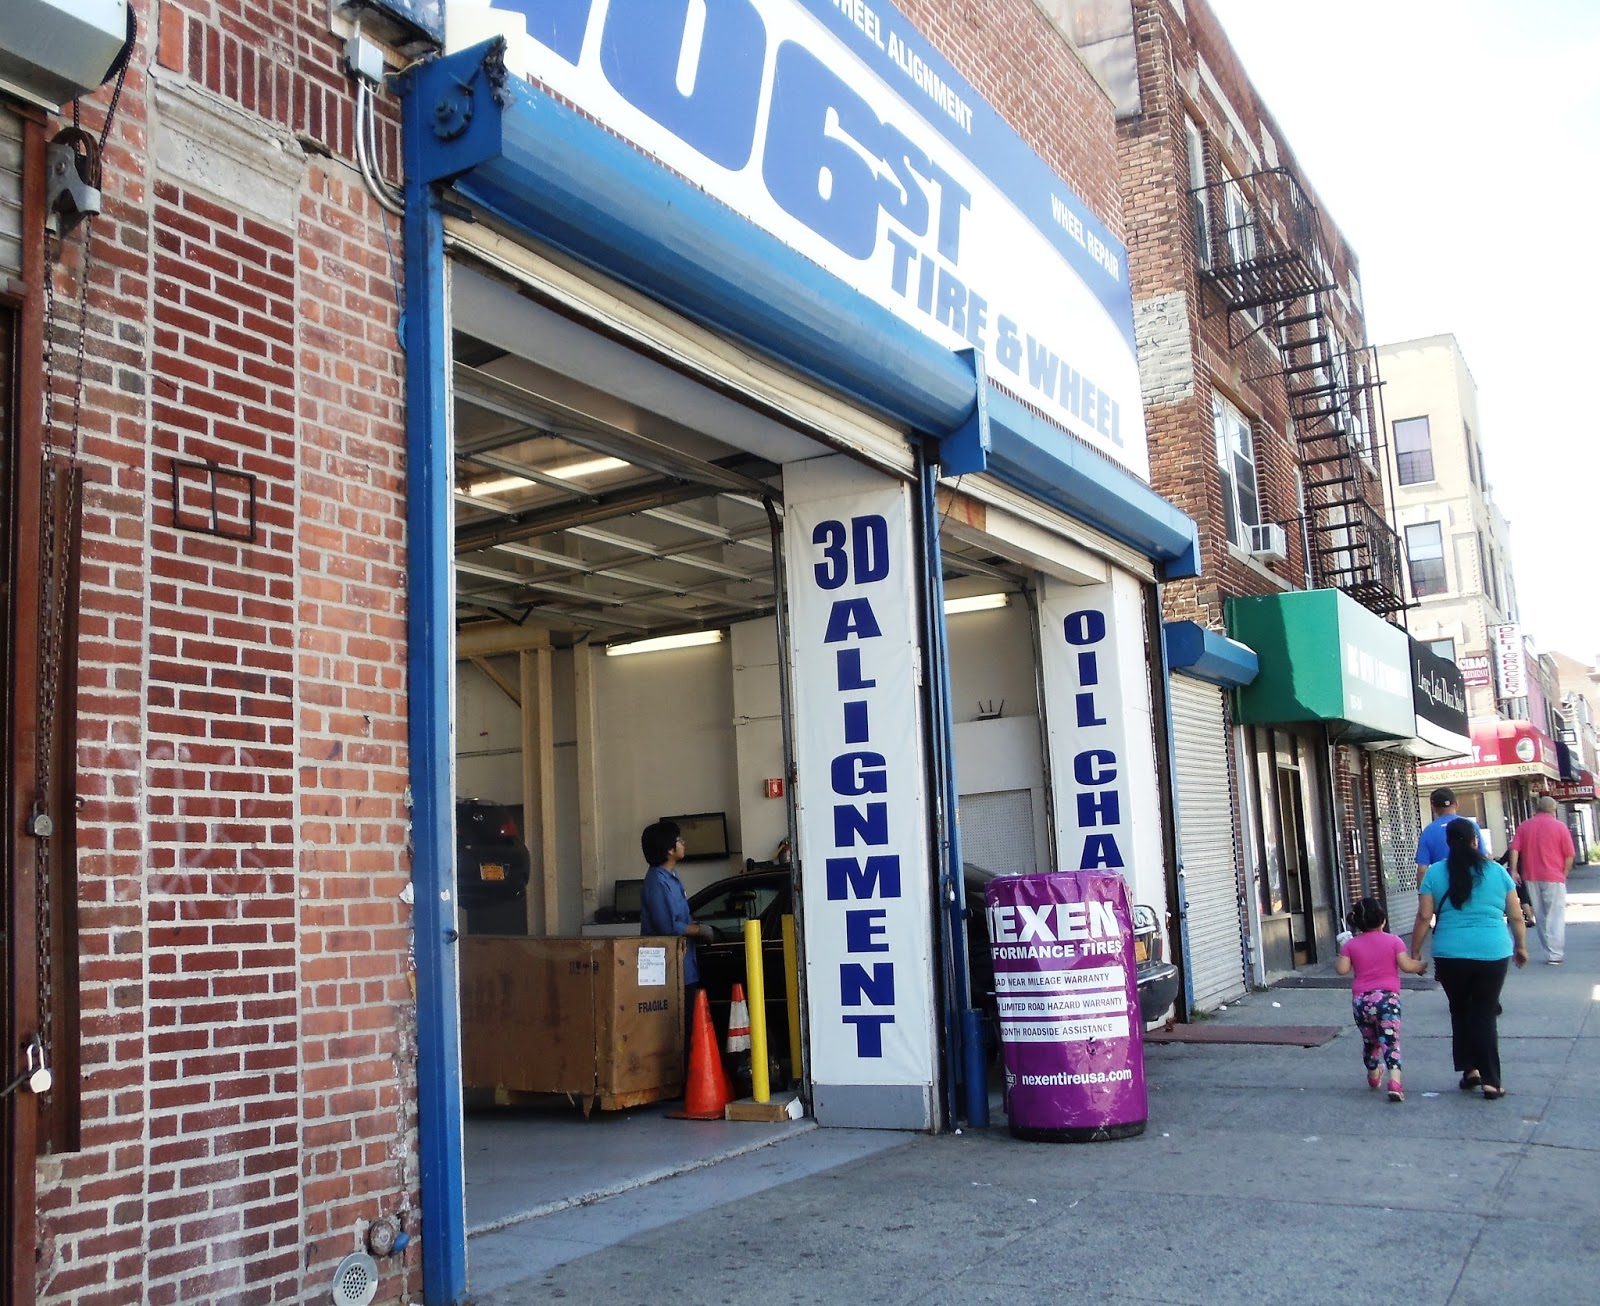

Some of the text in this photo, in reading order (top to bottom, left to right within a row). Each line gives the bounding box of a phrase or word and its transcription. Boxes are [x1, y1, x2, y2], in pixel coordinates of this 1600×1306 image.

[887, 30, 973, 135] ALIGNMENT
[1050, 192, 1120, 282] WHEEL REPAIR
[887, 227, 1124, 448] TIRE & WHEEL
[812, 514, 890, 591] 3D
[1063, 608, 1106, 728] OIL
[824, 596, 901, 1059] ALIGNMENT
[990, 940, 1122, 960] FORMANCE TIRES
[1008, 976, 1026, 987] WEAR
[1027, 976, 1062, 986] MILEAGE
[1064, 972, 1110, 984] WARRANTY
[638, 999, 669, 1014] FRAGILE
[1001, 1003, 1026, 1012] LIMITED
[1027, 1002, 1046, 1011] ROAD
[1047, 999, 1081, 1010] HAZARD
[1083, 996, 1123, 1009] WARRANTY
[1022, 1026, 1060, 1037] ROADSIDE
[1062, 1023, 1113, 1036] ASSISTANCE
[1021, 1067, 1132, 1086] nexentireusa.com
